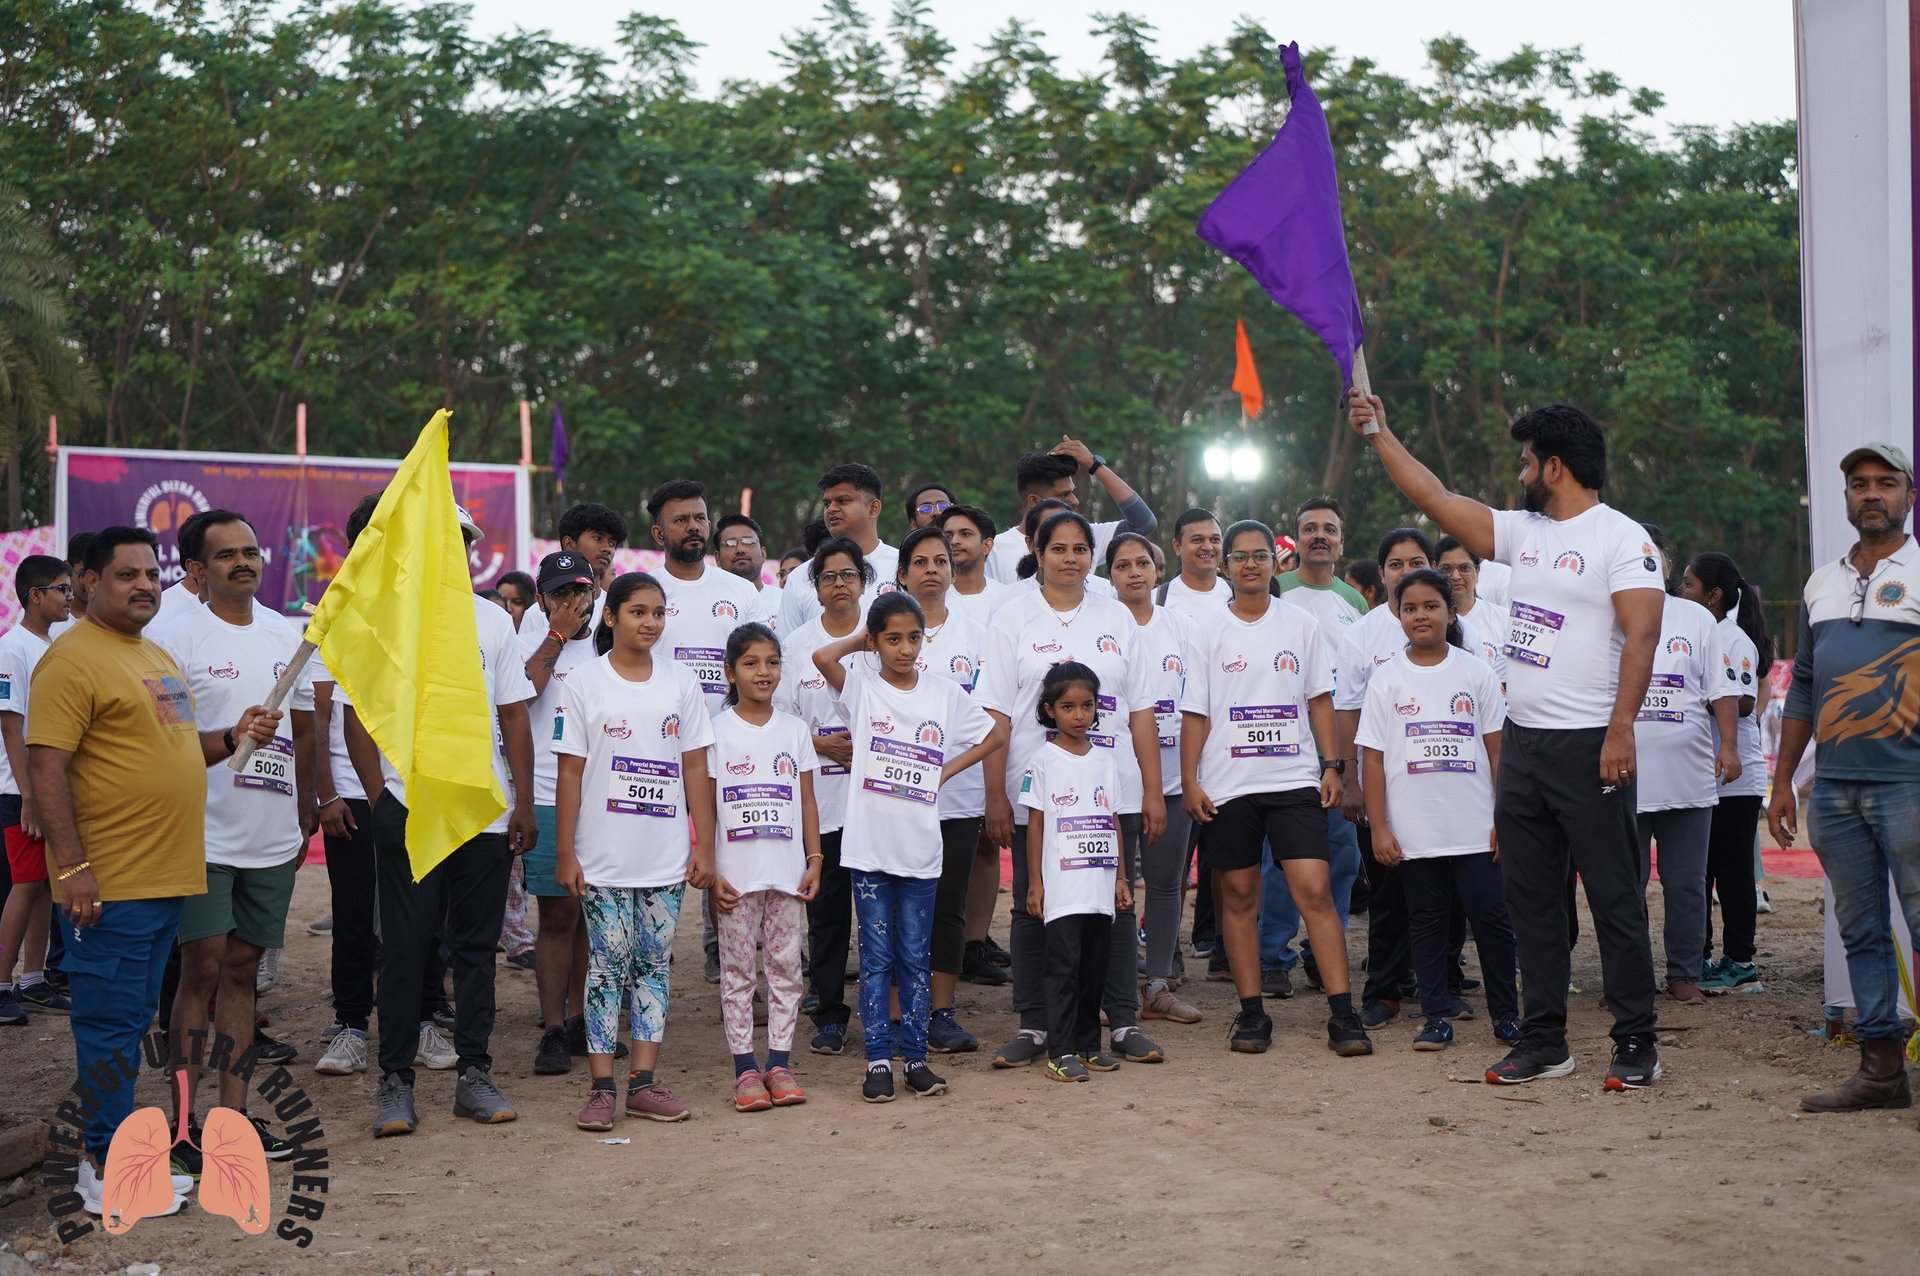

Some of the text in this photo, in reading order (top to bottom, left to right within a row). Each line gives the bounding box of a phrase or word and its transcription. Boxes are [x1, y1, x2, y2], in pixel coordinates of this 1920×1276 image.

[1524, 623, 1544, 634] KARLE
[1510, 630, 1536, 646] 5037
[693, 669, 721, 680] 032
[1644, 697, 1668, 707] 039
[1248, 730, 1281, 742] 5011
[888, 742, 927, 755] Powerful Marathon
[1424, 745, 1458, 757] 3033
[255, 760, 284, 777] 5020
[891, 758, 912, 766] BHUPESH
[913, 763, 930, 771] SHUKLA
[634, 776, 657, 784] PANDURANG
[884, 766, 922, 784] 5019
[628, 785, 663, 800] 5014
[742, 810, 779, 824] 5013
[1078, 841, 1109, 854] 5023
